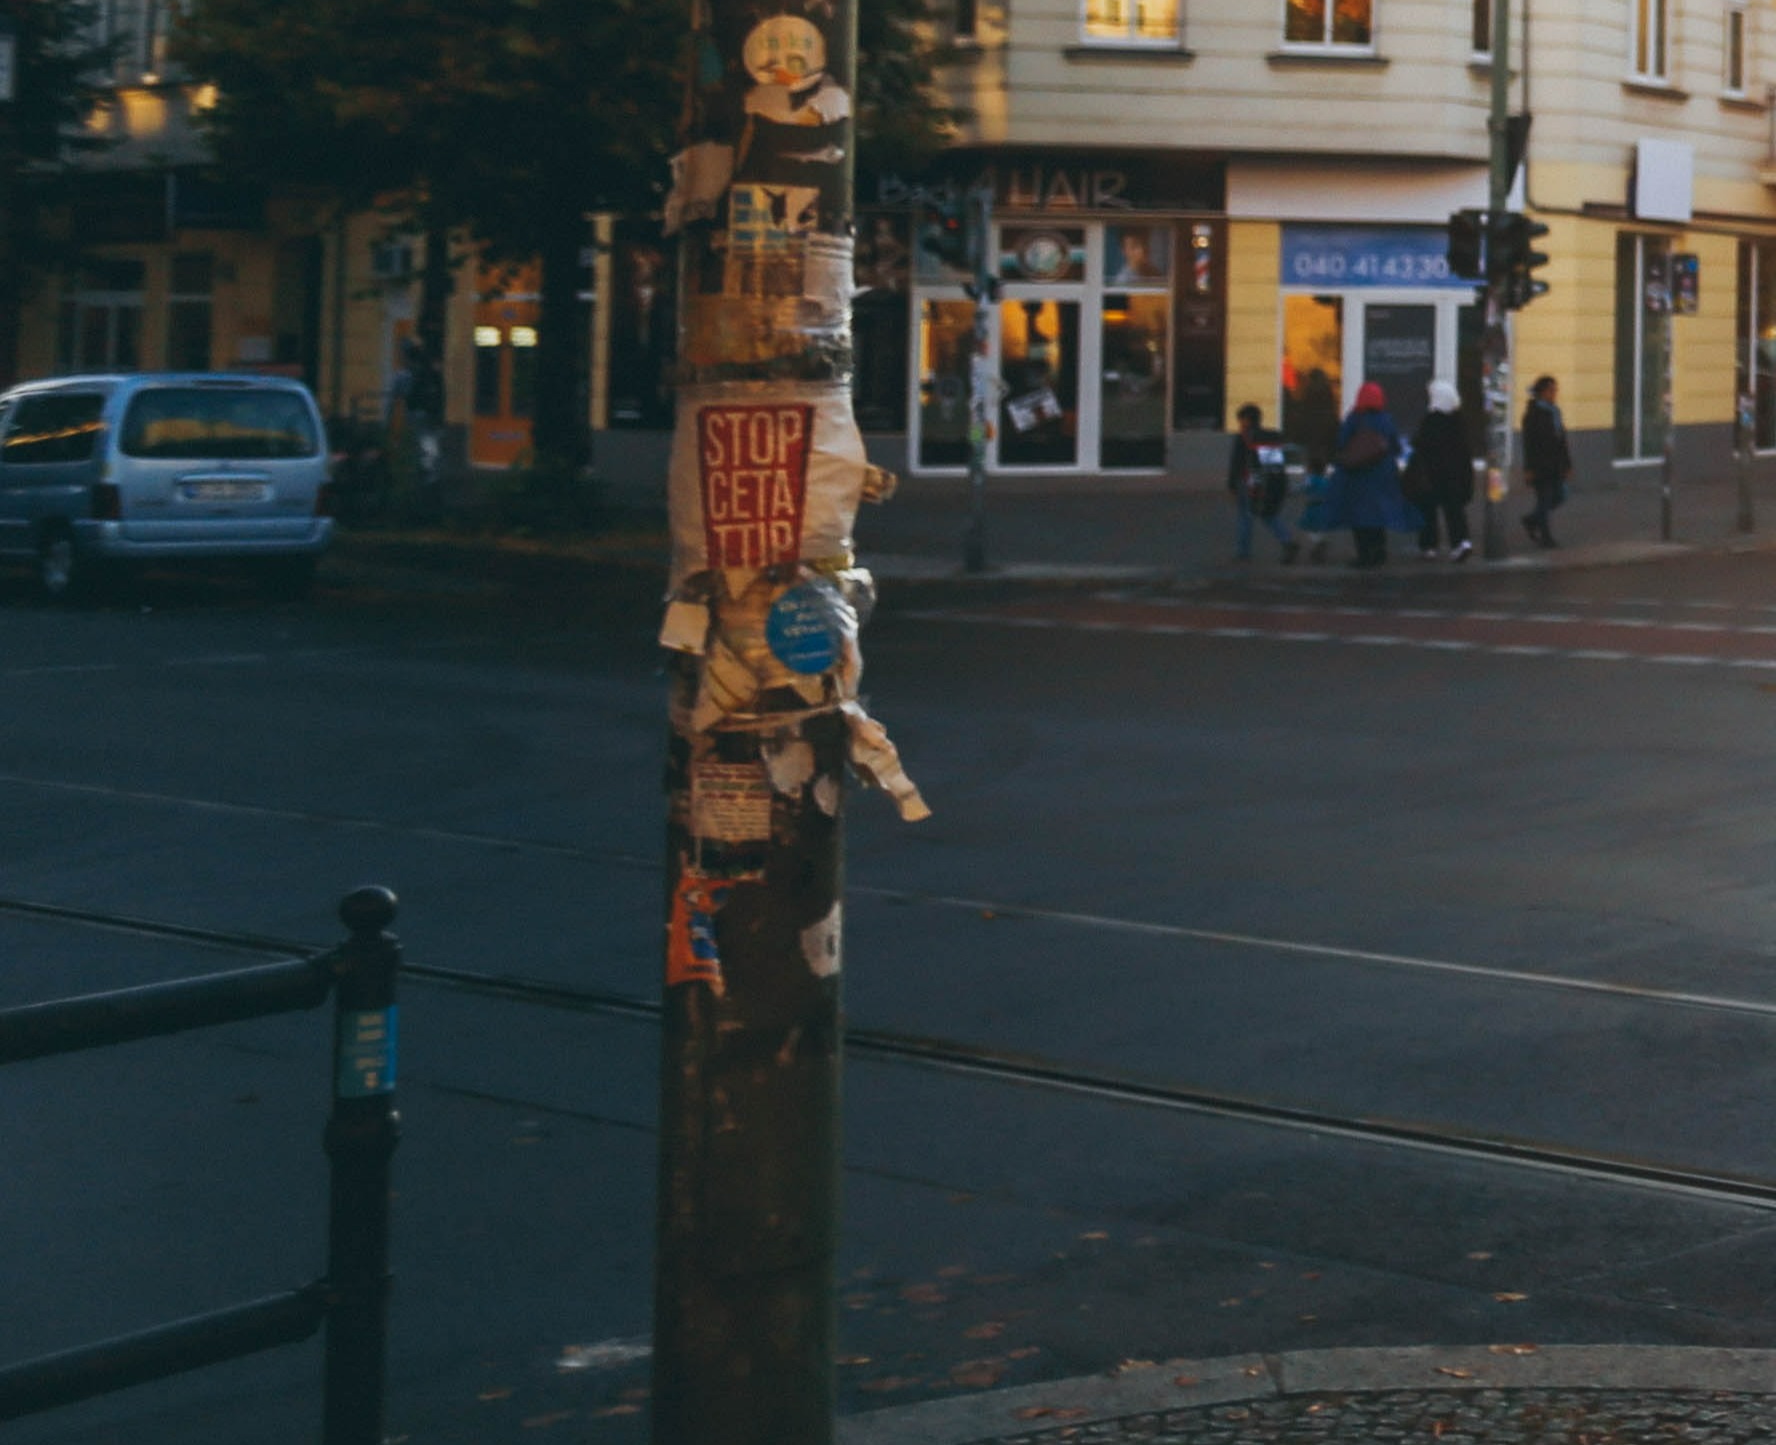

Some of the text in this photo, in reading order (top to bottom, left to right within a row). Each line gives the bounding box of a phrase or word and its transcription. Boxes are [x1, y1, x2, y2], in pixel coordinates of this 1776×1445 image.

[1294, 252, 1346, 278] 040
[705, 410, 803, 467] STOP
[708, 469, 796, 521] CETA
[712, 522, 795, 569] TTIP
